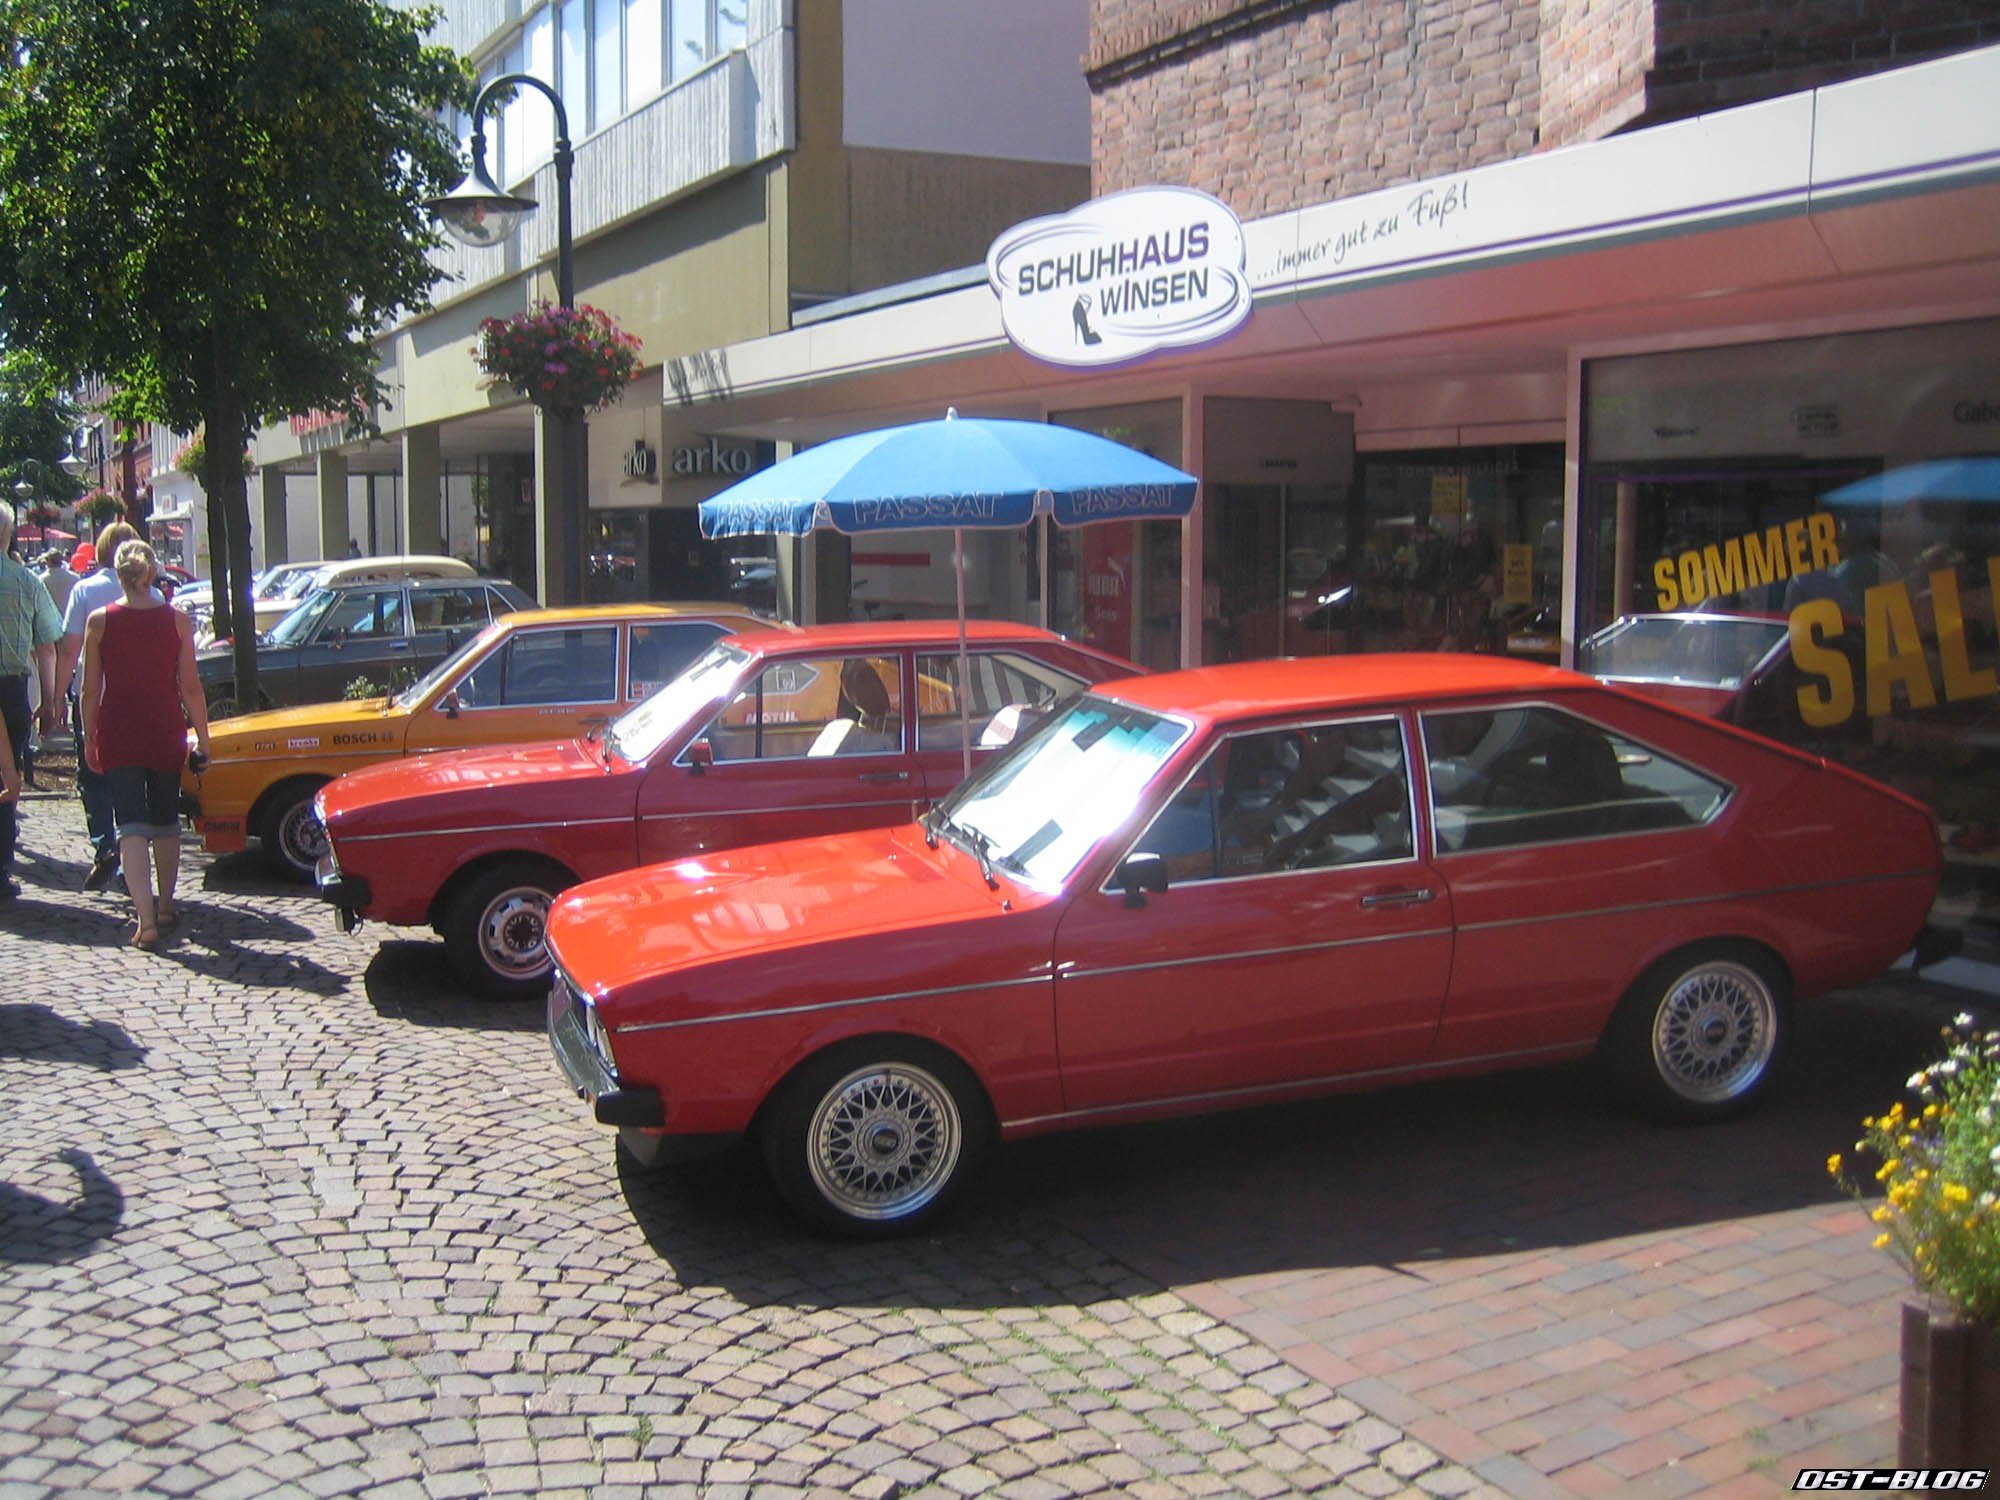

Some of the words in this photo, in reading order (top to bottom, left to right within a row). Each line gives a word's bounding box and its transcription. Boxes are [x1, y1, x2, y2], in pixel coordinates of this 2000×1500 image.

[1333, 220, 1367, 265] gut
[1373, 216, 1399, 241] zu
[1407, 179, 1468, 229] Fuß!
[1018, 222, 1210, 297] SCHUHHAUS
[1099, 268, 1209, 317] WINSEN
[623, 442, 647, 478] arko
[673, 437, 752, 475] arko
[715, 498, 795, 525] PASSAT
[852, 491, 1004, 524] PASSAT
[1070, 483, 1177, 514] PASSAT
[1653, 512, 1841, 612] SOMMER
[333, 732, 377, 745] BOSCH
